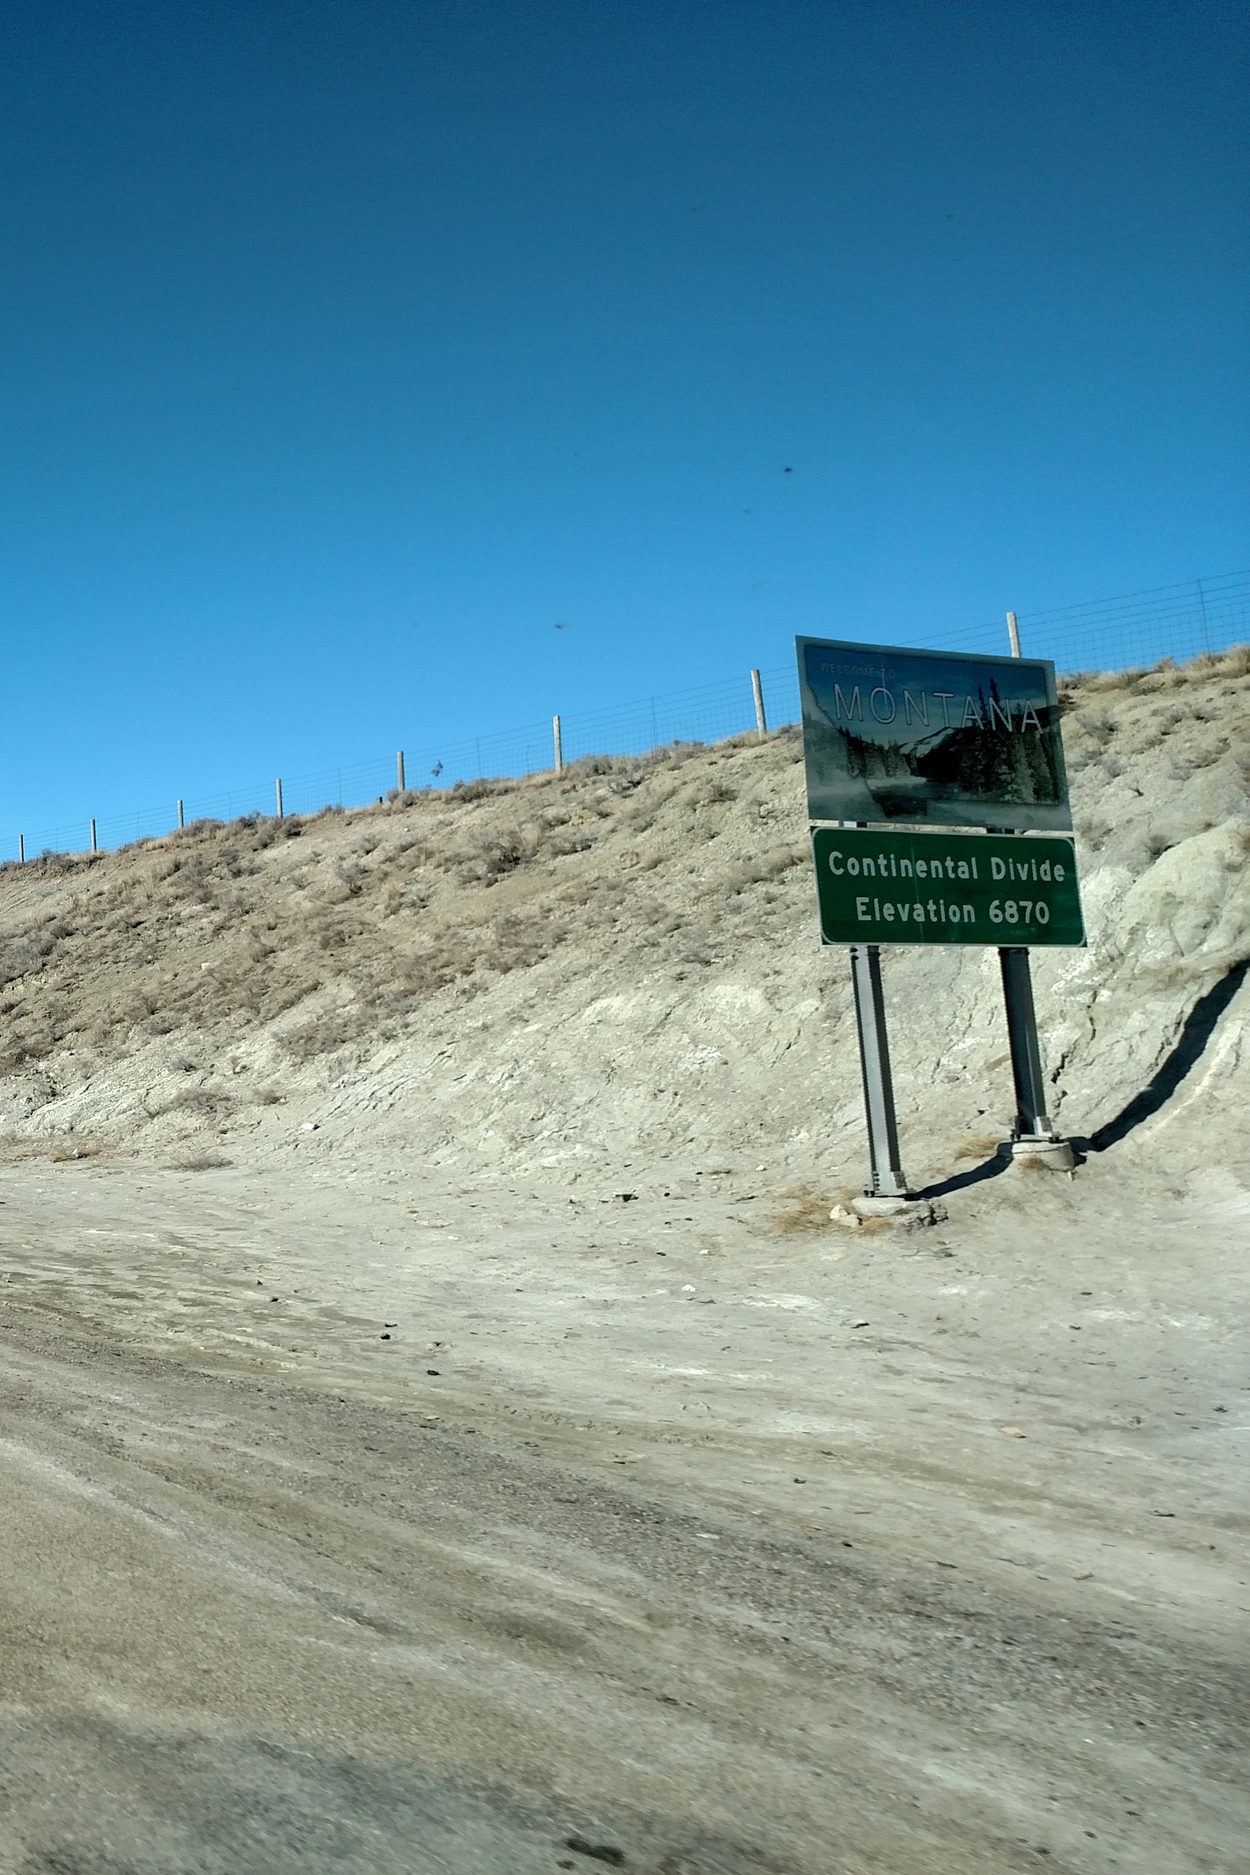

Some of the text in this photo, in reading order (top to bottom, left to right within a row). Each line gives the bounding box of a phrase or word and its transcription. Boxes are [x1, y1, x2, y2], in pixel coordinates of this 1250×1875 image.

[820, 663, 875, 678] WELCOME
[834, 683, 1044, 734] MONTANA
[828, 851, 1066, 882] Continental Divide
[855, 897, 1050, 924] Elevation 6870
